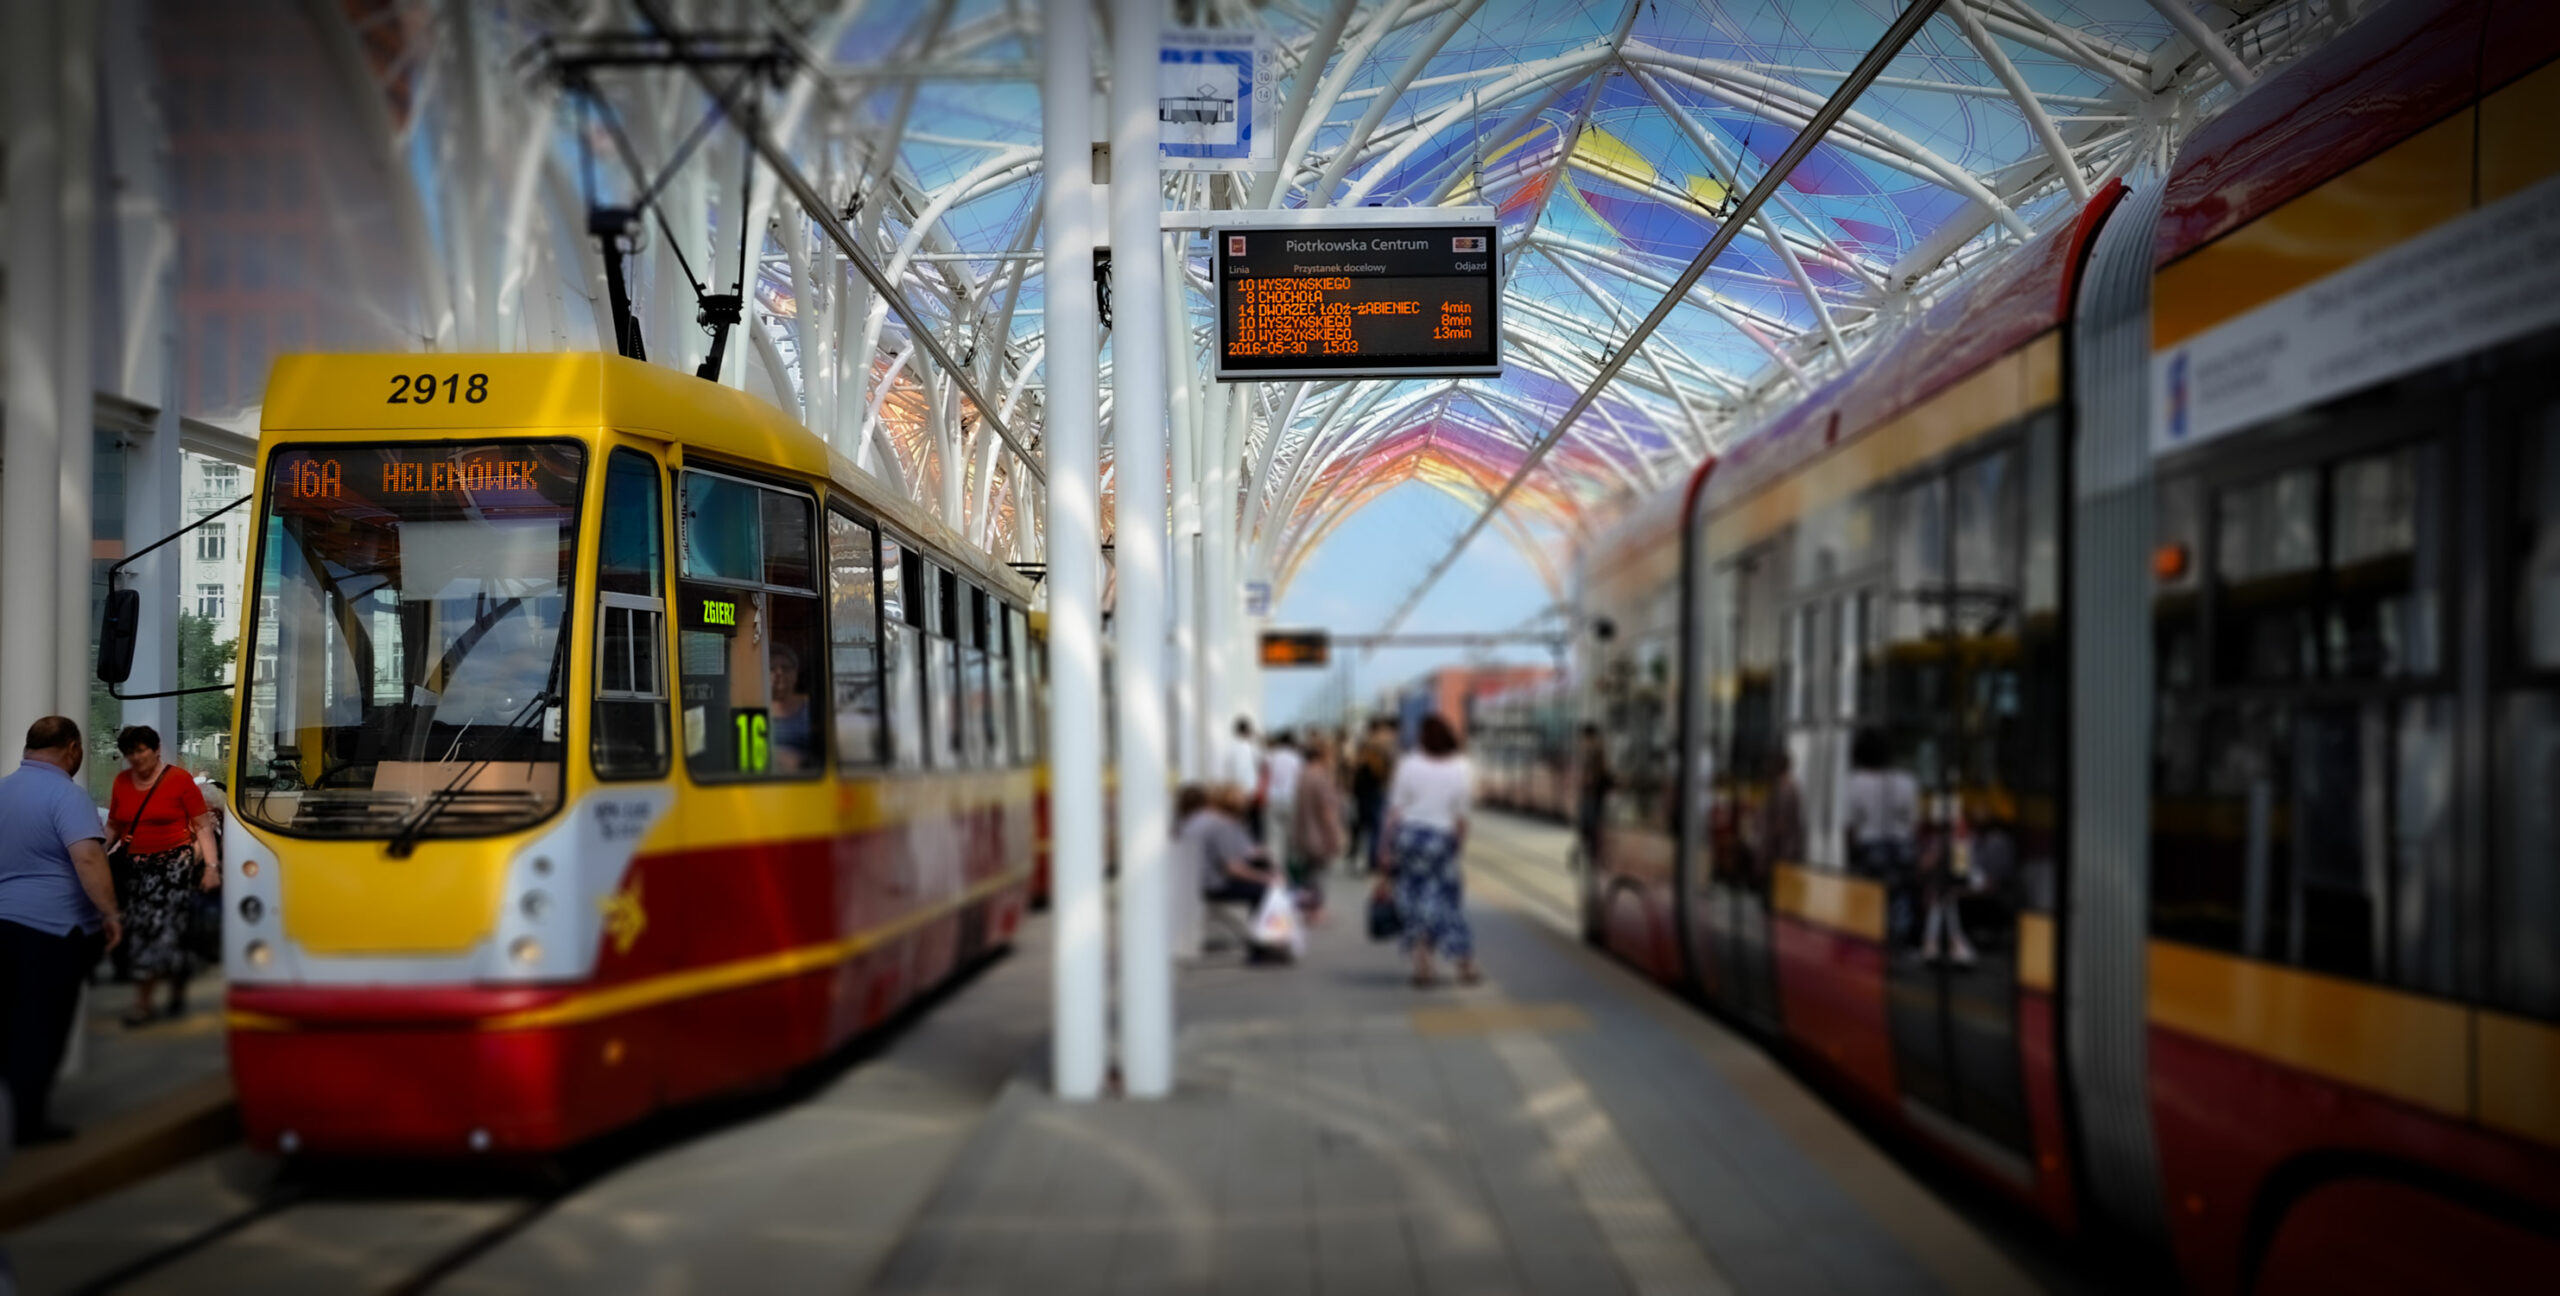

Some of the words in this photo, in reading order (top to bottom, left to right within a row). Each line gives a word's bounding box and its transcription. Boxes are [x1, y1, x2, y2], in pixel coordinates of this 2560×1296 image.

[1286, 238, 1367, 252] Piotrkowska
[1371, 238, 1429, 251] Centrum
[1229, 265, 1250, 274] Linia
[1293, 264, 1341, 274] Przystanek
[1343, 263, 1387, 273] docelowy
[1454, 262, 1487, 272] Odjazd
[1238, 279, 1255, 291] 10
[1258, 277, 1351, 291] WYSZYŃSKIEGO
[1246, 291, 1255, 303] 8
[1258, 290, 1323, 303] CHOCHOŁA
[1238, 304, 1255, 317] 14
[1258, 303, 1316, 316] DWORZEC
[1441, 301, 1472, 313] 4min
[1238, 316, 1256, 330] 10
[1258, 315, 1352, 329] WYSZYŃSKIEGO
[1441, 313, 1472, 326] 8min
[1239, 329, 1256, 342] 10
[1259, 328, 1352, 342] WYSZYŃSKIEGO
[1433, 326, 1472, 339] 13min
[1228, 341, 1308, 355] 2016-05-30
[1322, 340, 1359, 354] 15:03
[387, 373, 489, 404] 2918
[289, 459, 341, 498] 16A
[383, 457, 539, 492] HELENÓWEK
[703, 600, 736, 626] ZGIERZ
[736, 714, 768, 772] 16
